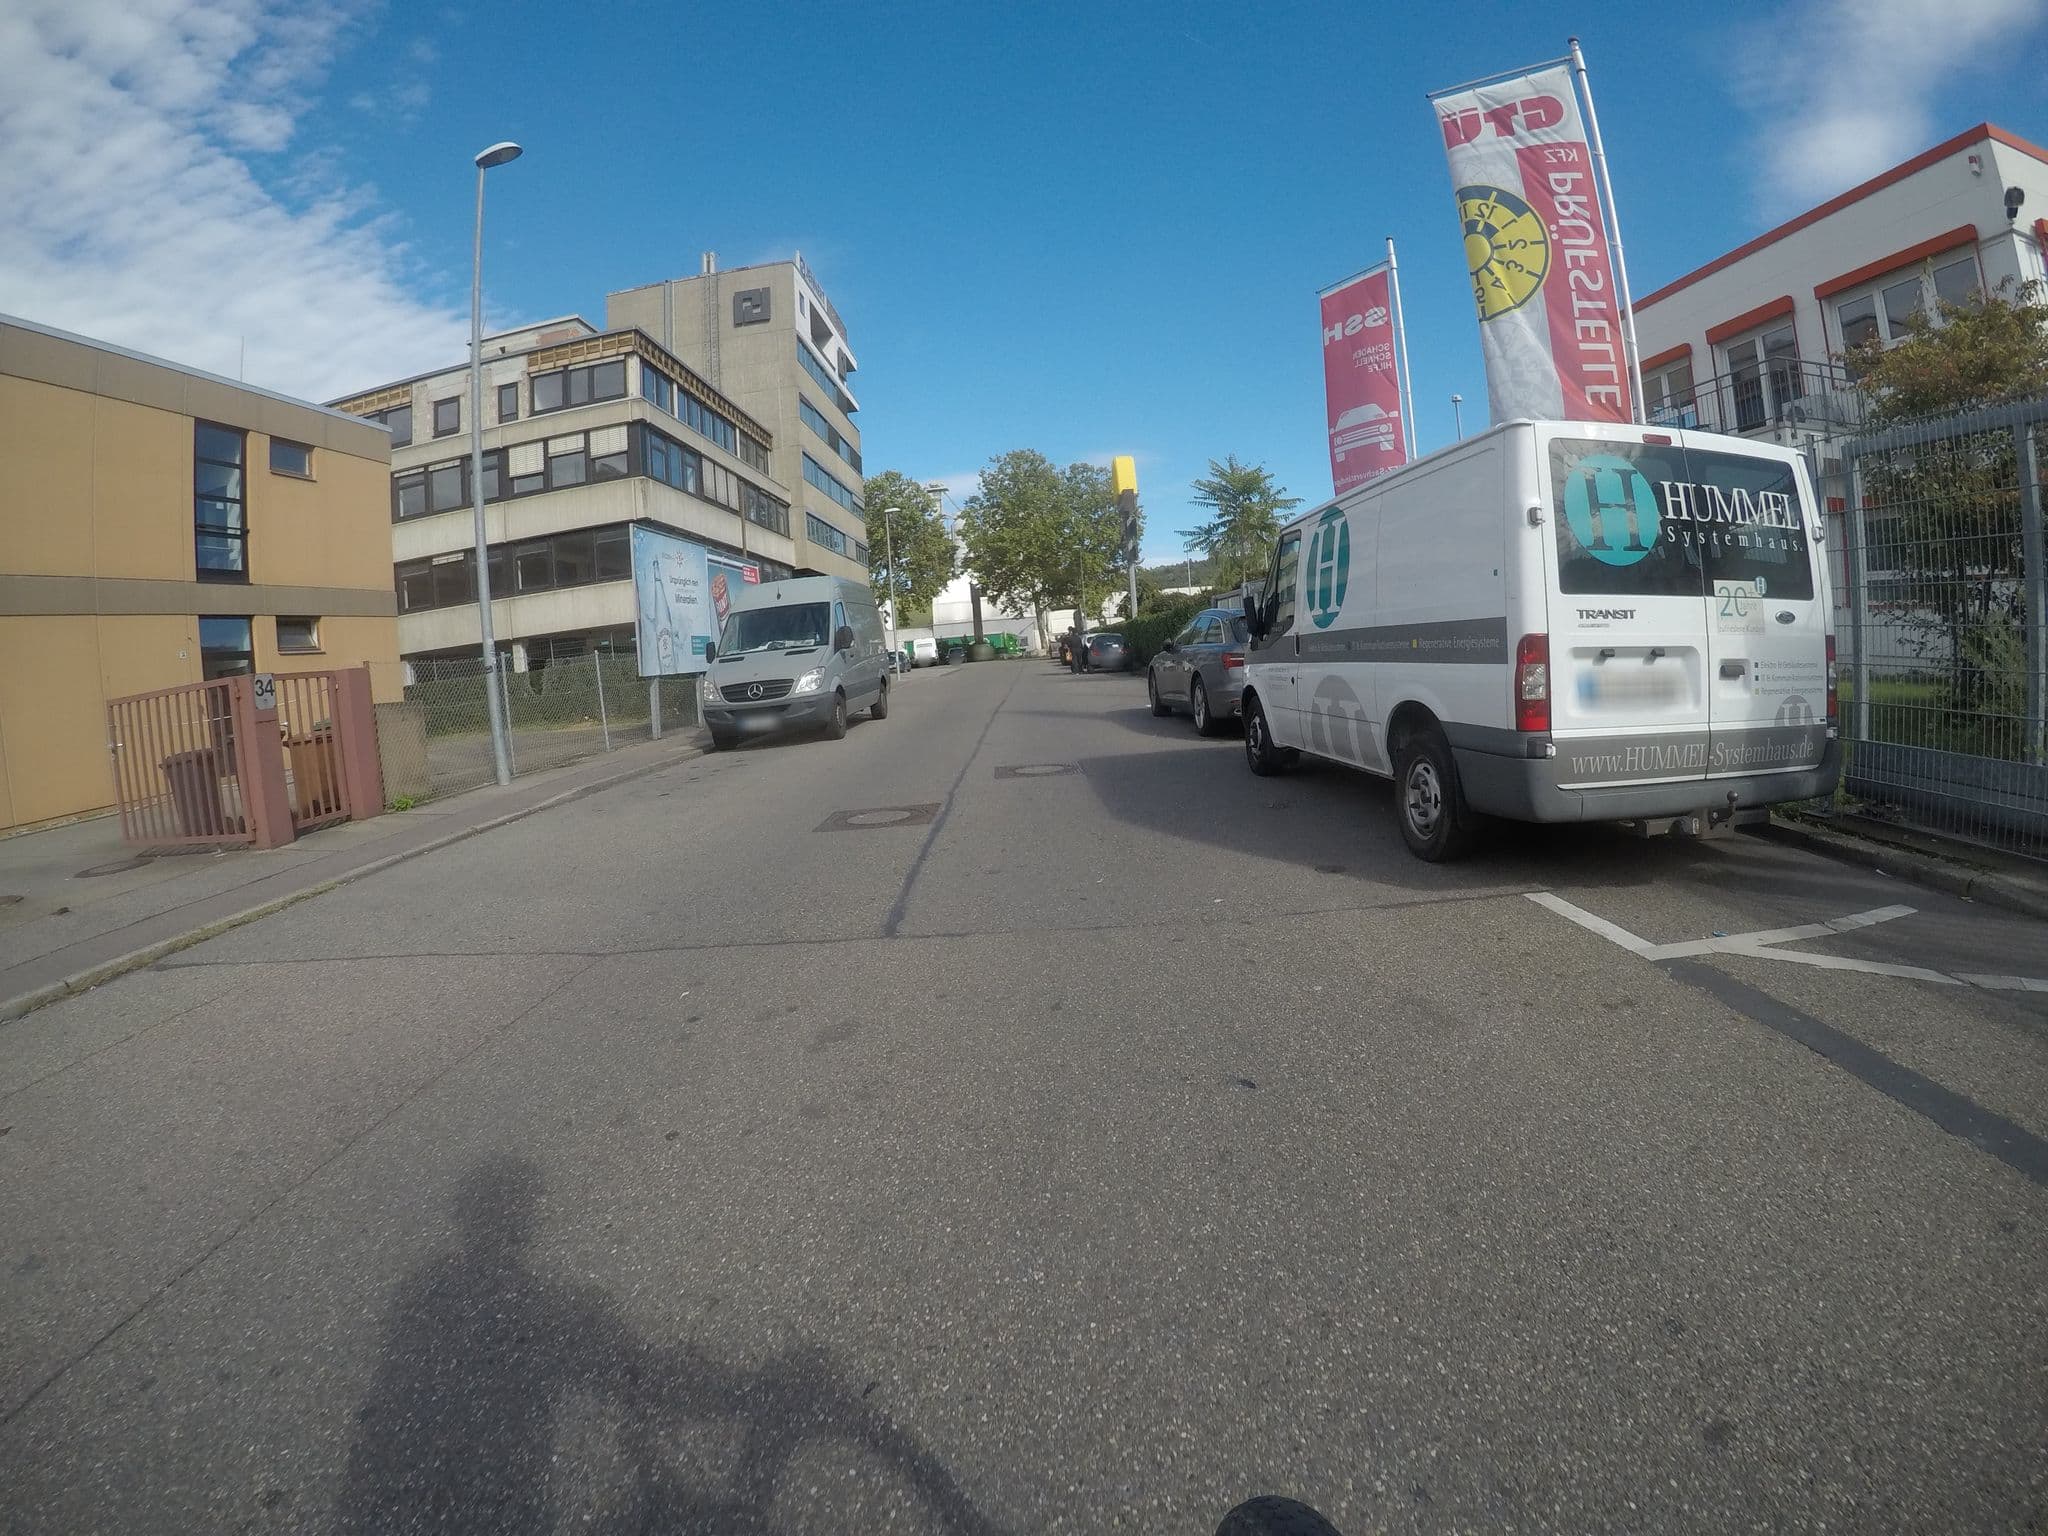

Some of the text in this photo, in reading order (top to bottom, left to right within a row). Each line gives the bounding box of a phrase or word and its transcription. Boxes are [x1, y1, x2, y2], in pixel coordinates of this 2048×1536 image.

[1660, 480, 1800, 530] HUMMEL
[1575, 609, 1637, 620] TRANSIT
[255, 679, 275, 697] 34
[1572, 735, 1814, 775] www.HUMMEL-Systemhaus.de
